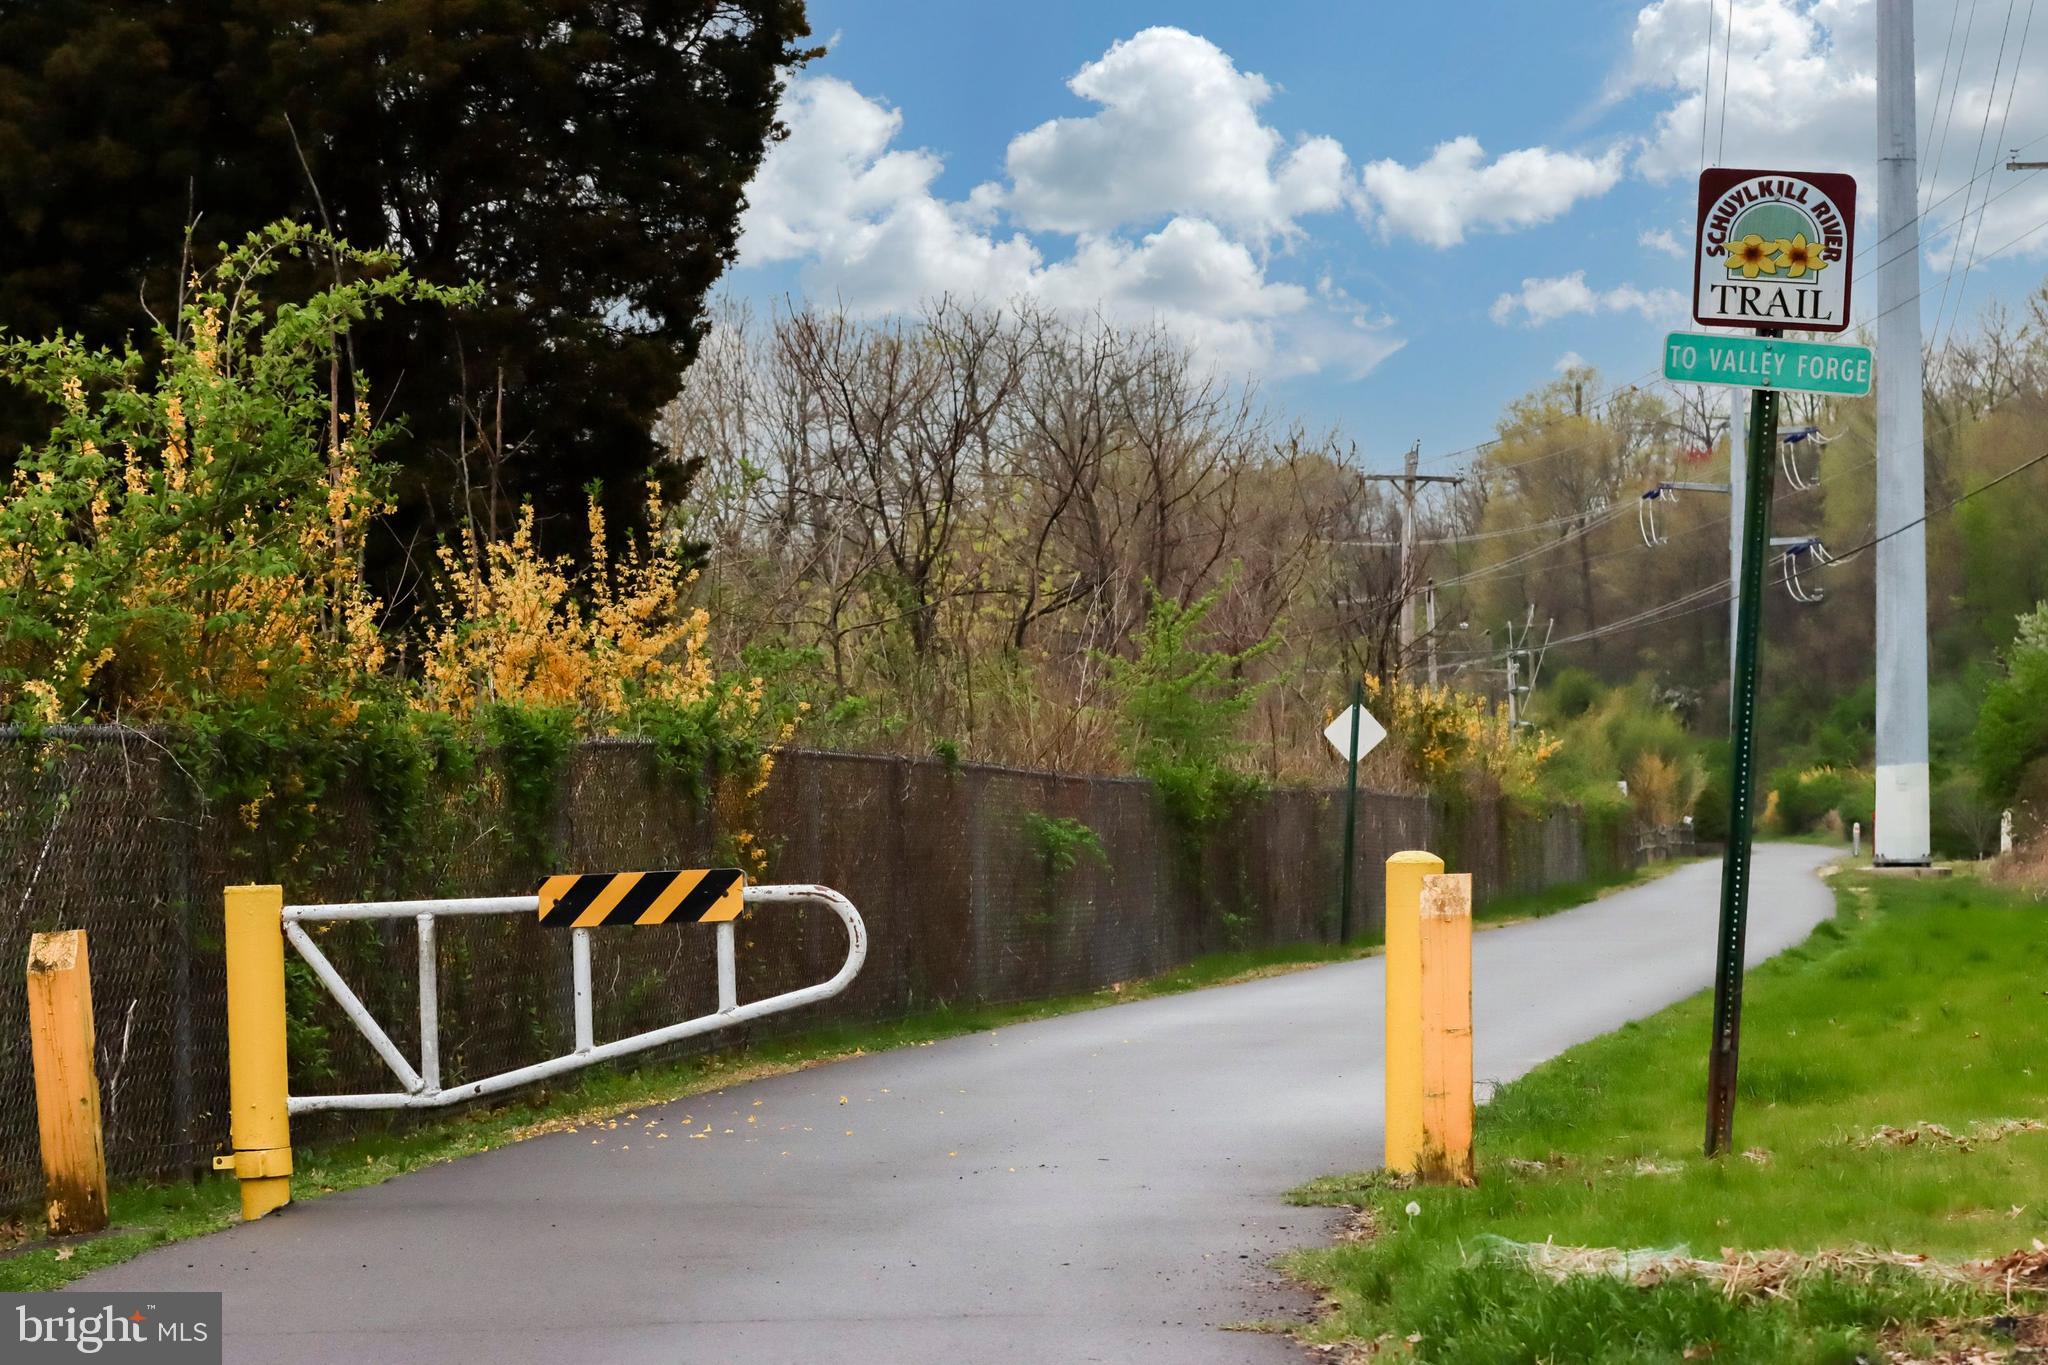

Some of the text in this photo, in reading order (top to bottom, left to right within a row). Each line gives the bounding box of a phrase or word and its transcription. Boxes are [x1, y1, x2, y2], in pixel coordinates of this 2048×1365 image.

[1707, 180, 1842, 262] SCHUYLKILL RIVER
[1710, 284, 1832, 320] TRAIL
[1670, 345, 1867, 383] TO VALLEY FORGE
